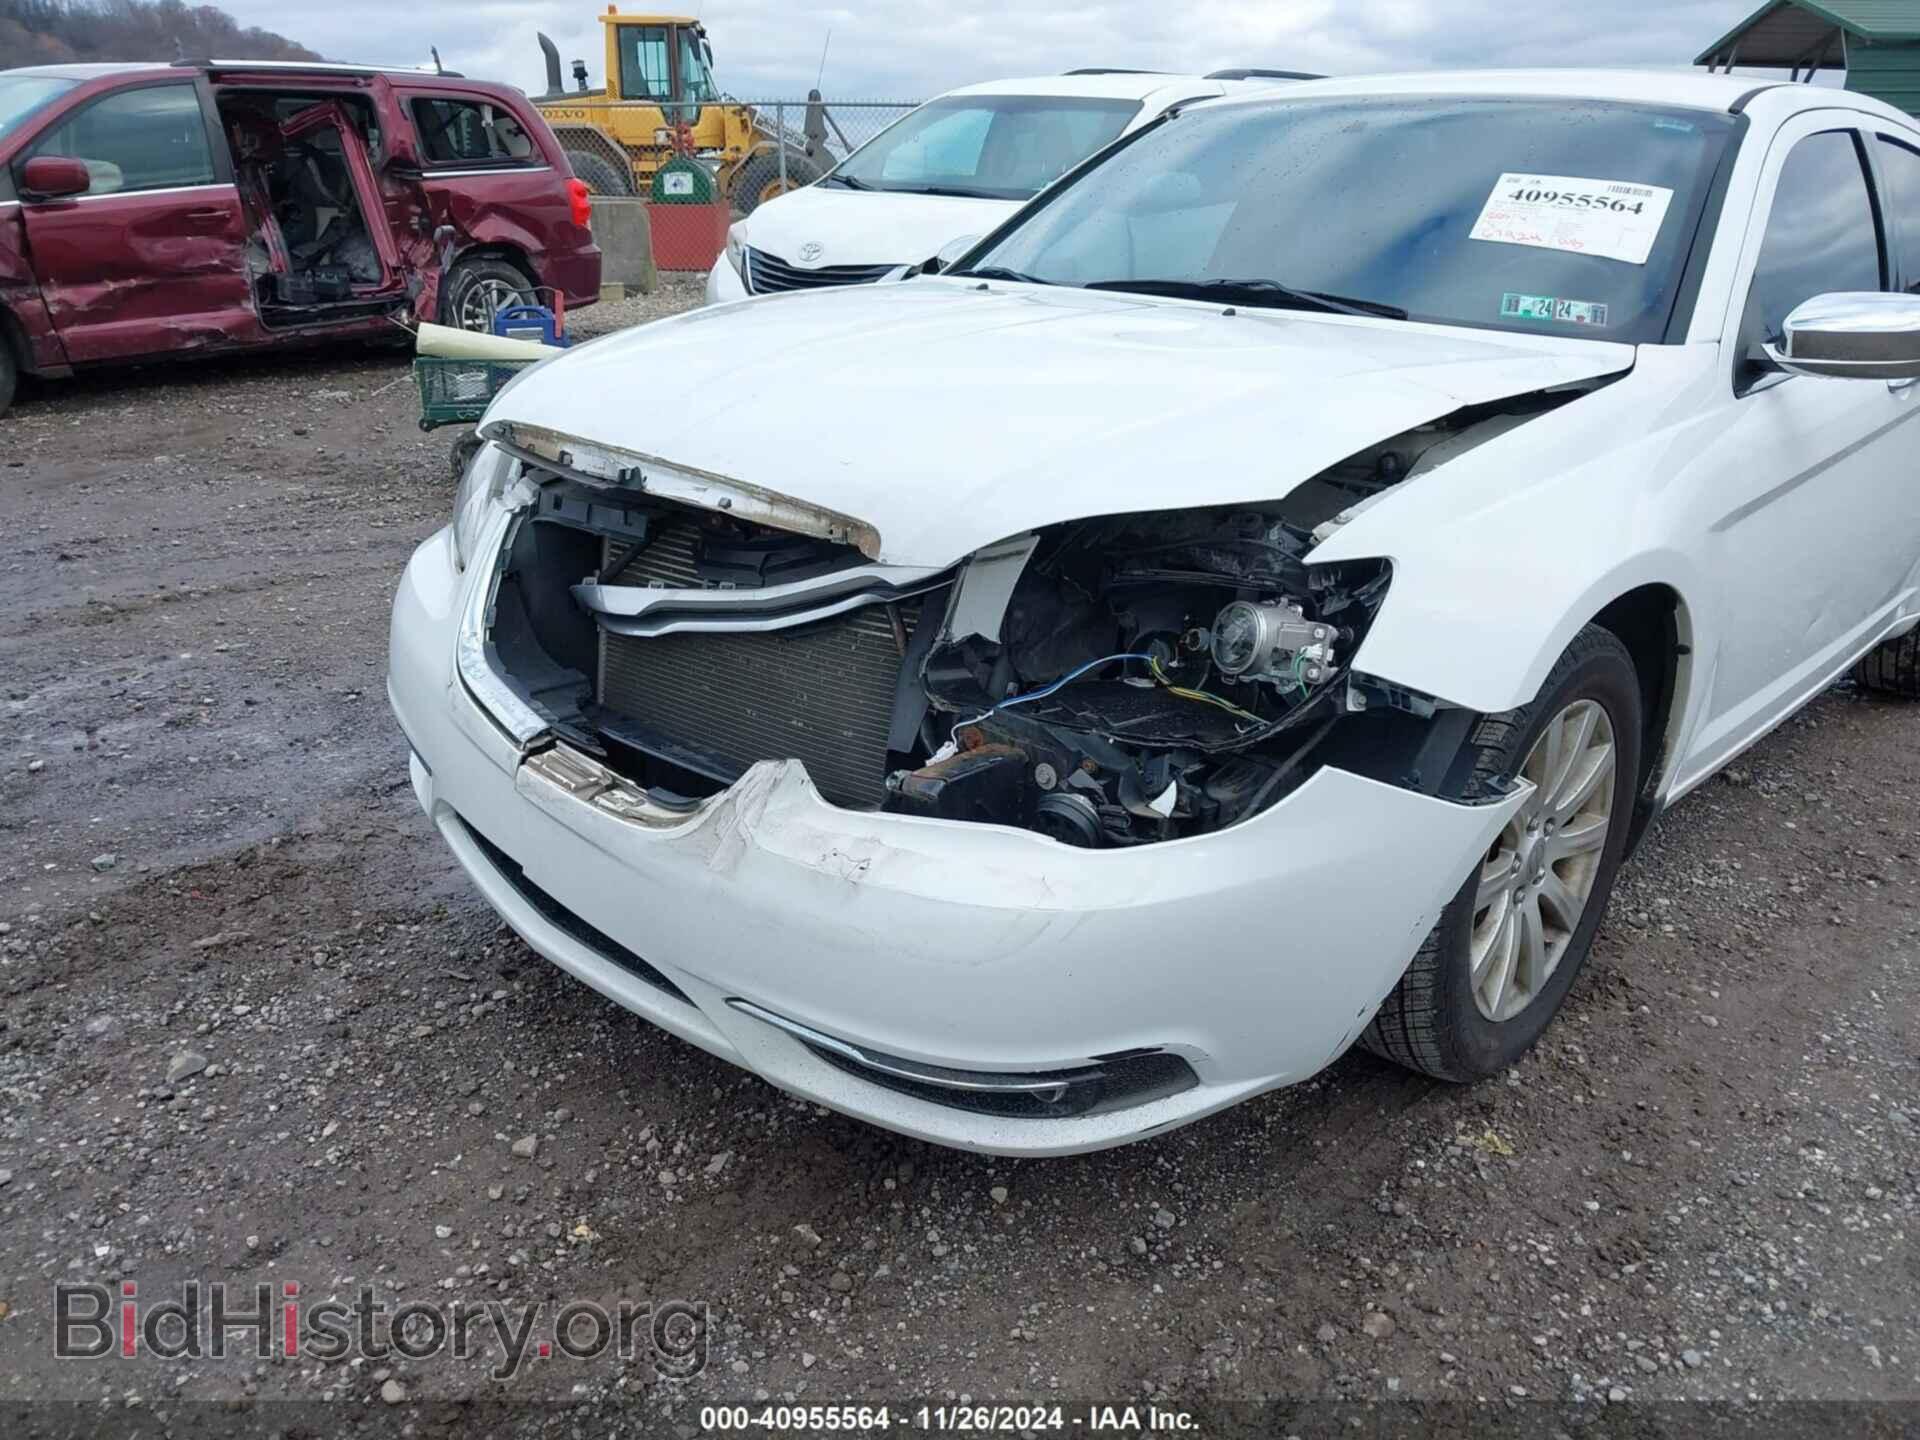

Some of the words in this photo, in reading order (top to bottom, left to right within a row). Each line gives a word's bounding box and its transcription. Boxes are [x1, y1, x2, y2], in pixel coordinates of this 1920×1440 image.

[1508, 188, 1644, 215] 40955564
[1538, 299, 1552, 316] 24
[1558, 301, 1572, 318] 24
